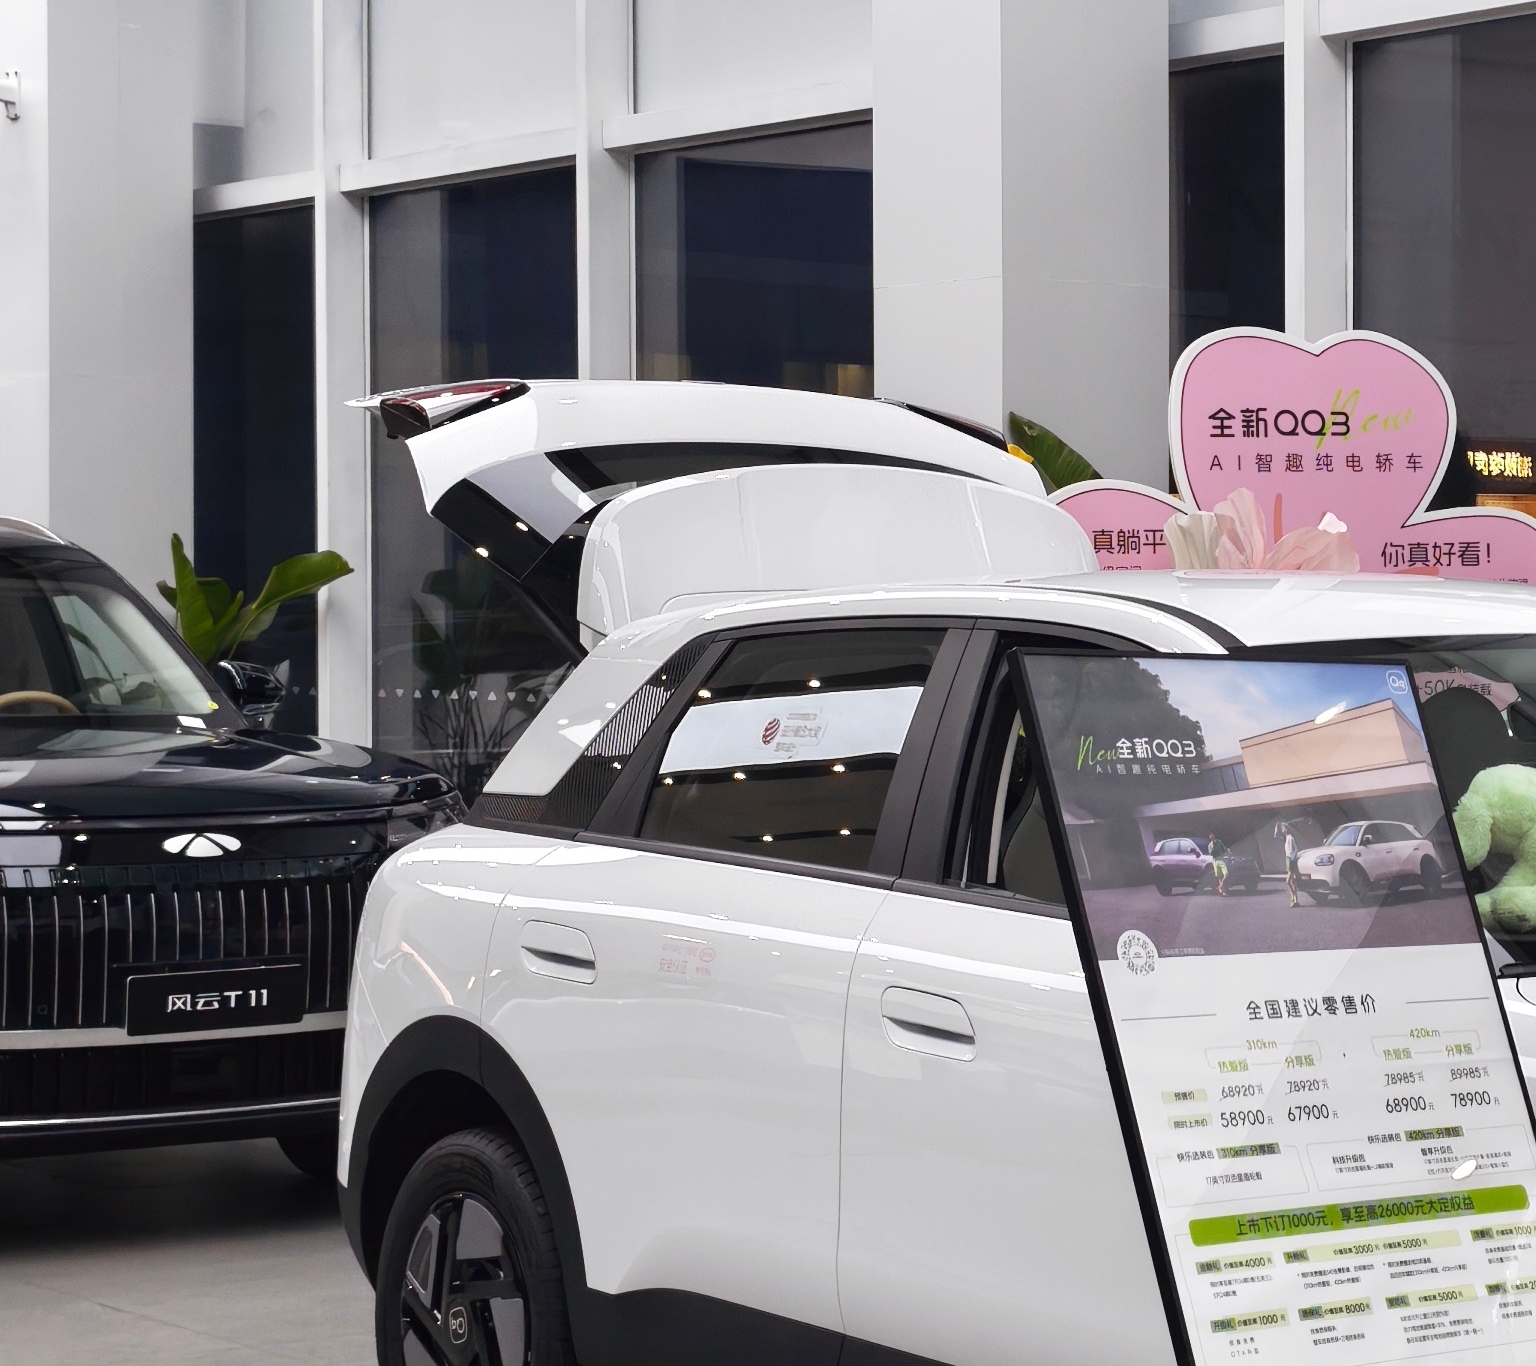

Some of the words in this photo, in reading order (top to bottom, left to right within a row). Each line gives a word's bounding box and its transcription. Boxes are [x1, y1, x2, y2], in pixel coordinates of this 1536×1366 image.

[1207, 406, 1351, 439] 全新QQ3
[1092, 528, 1167, 555] 真躺平
[1115, 737, 1197, 759] 全新QQ3
[166, 988, 268, 1014] 风云T11
[1246, 993, 1376, 1021] 全国建议零售价
[1246, 1039, 1278, 1051] 310km
[1409, 1028, 1441, 1039] 420km
